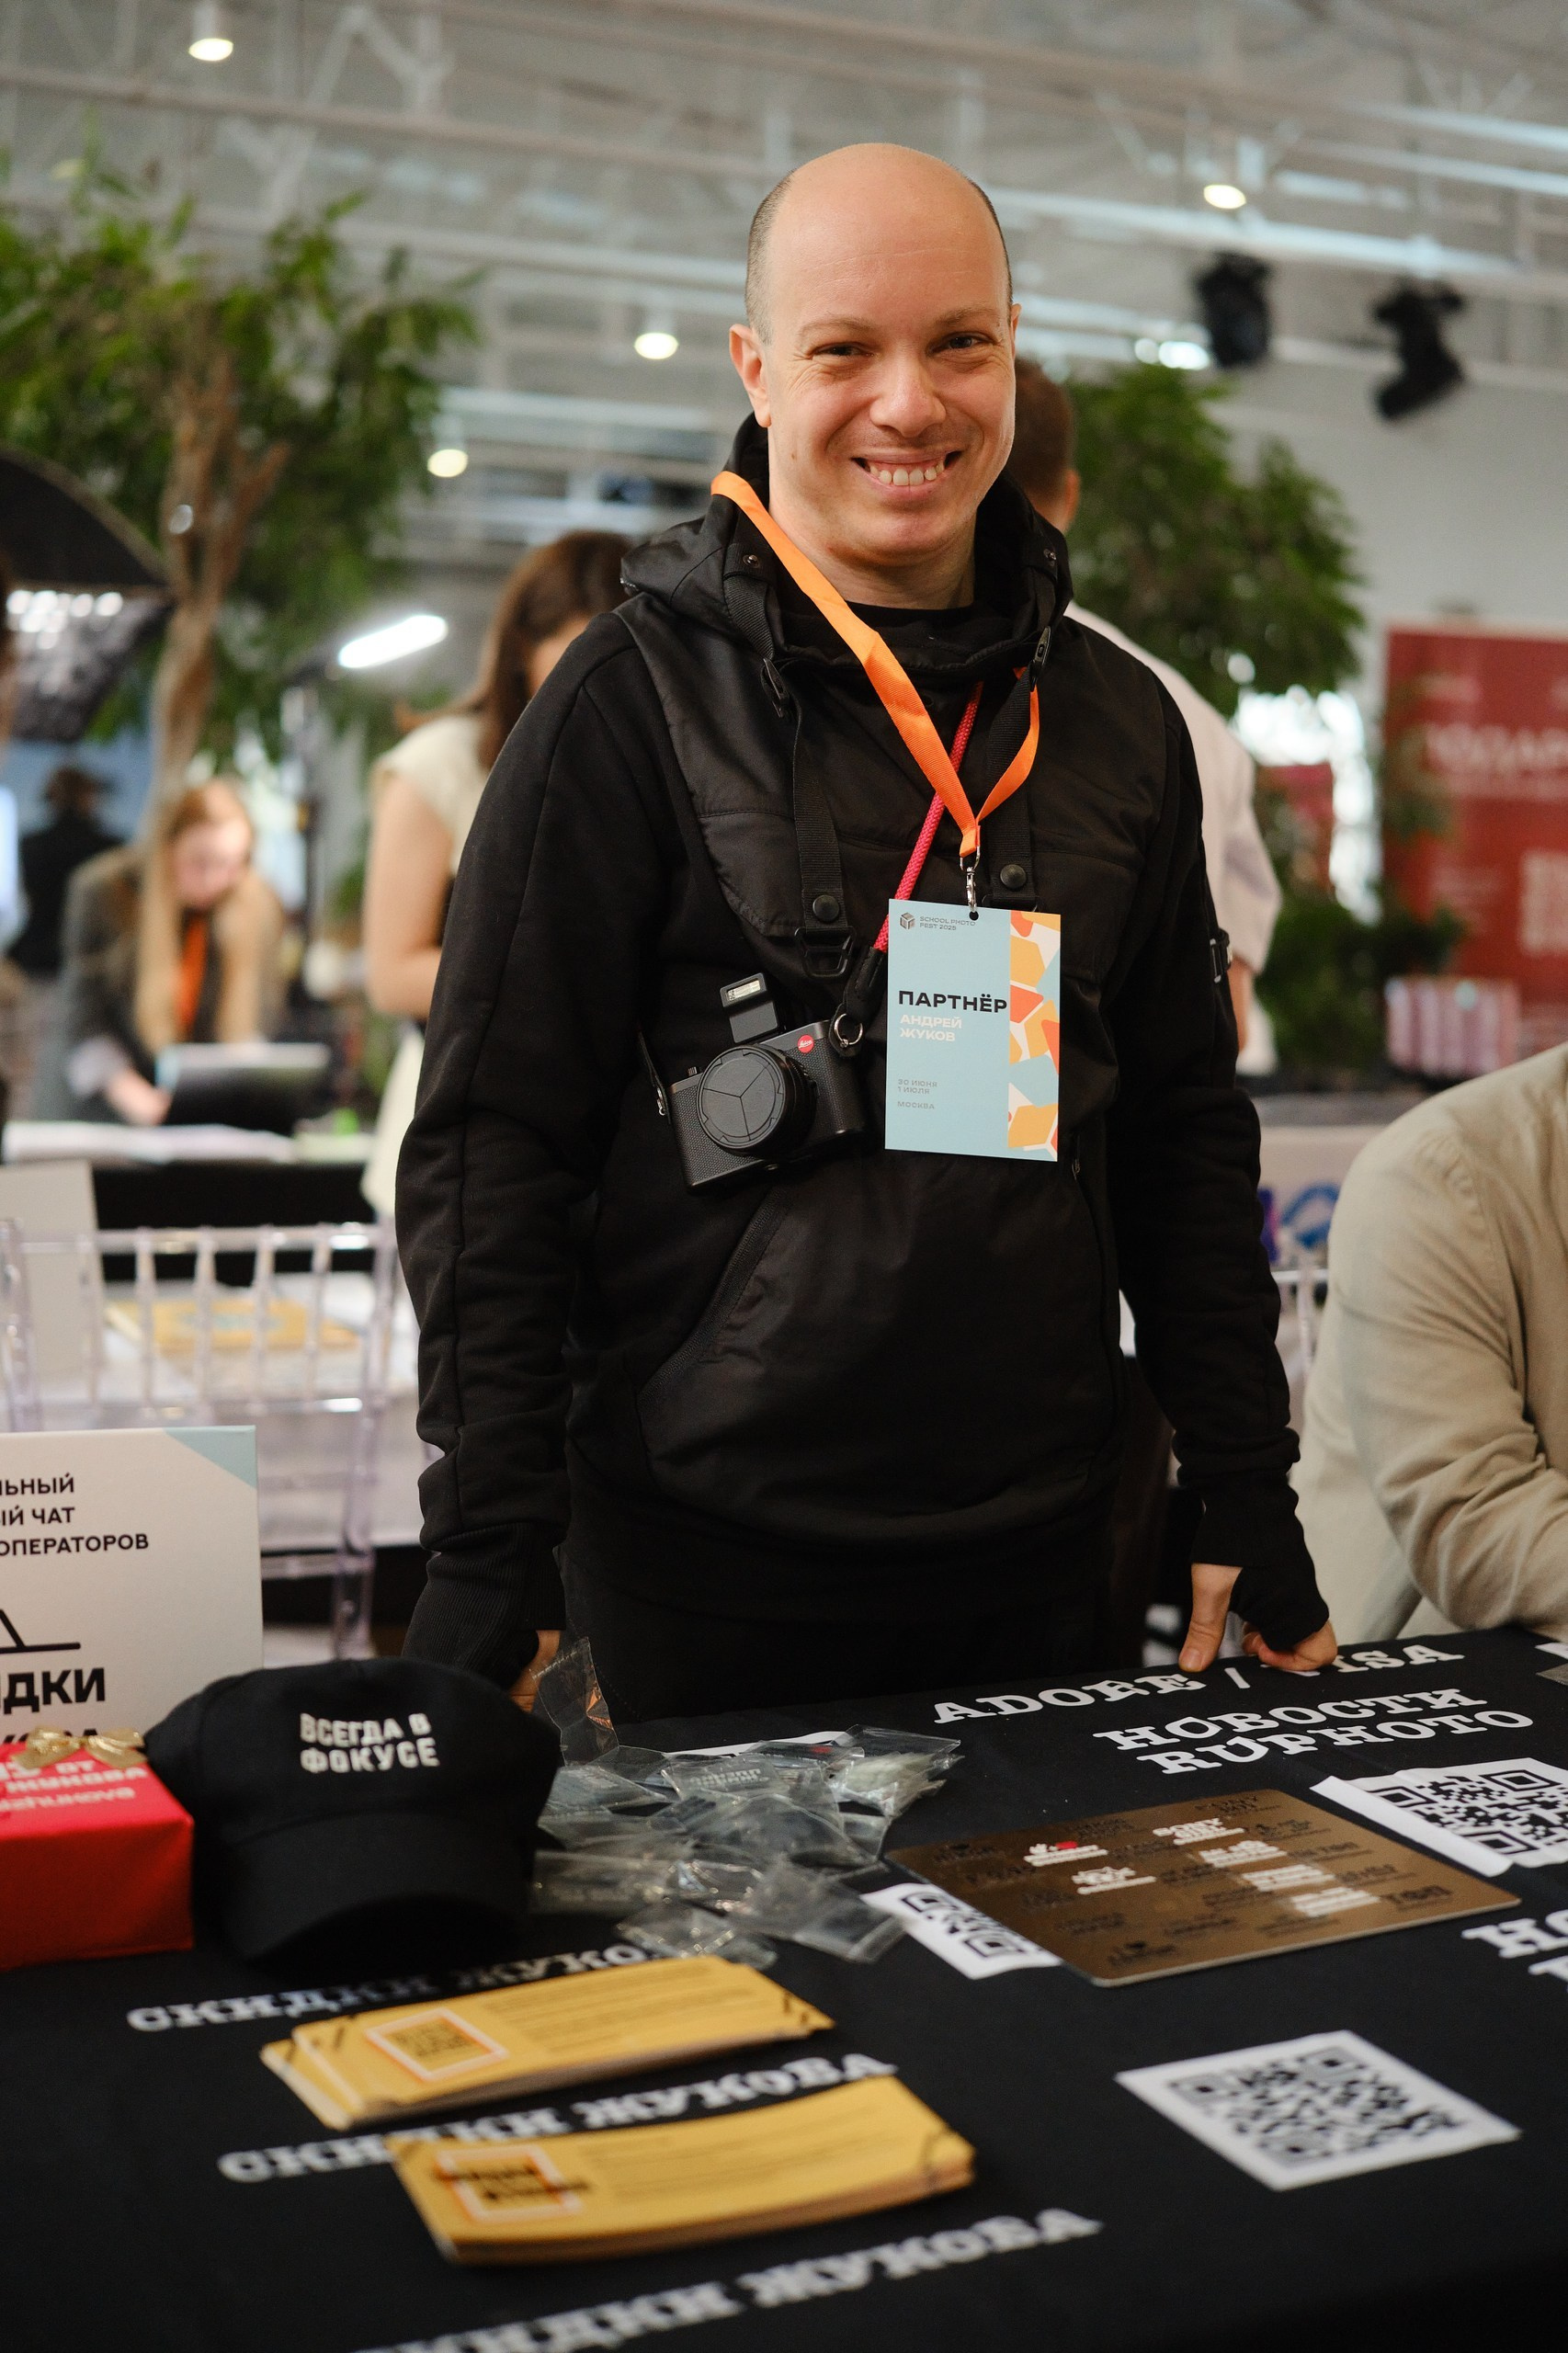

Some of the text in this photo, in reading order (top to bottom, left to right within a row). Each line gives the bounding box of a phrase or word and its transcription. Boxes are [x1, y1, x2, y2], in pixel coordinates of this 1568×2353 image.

[920, 915, 949, 925] SCHOOL
[899, 990, 1007, 1013] ПАРТНЁР
[900, 1014, 962, 1029] АНДРЕЙ
[900, 1028, 956, 1041] ЖУКОВ
[903, 1086, 930, 1095] ИЮЛЯ
[911, 1079, 937, 1087] ИЮНЯ
[897, 1100, 935, 1109] МОСКВА
[0, 1472, 74, 1496] ЬНЫЙ
[32, 1506, 75, 1525] ЧАТ
[0, 1534, 149, 1556] ОПЕРАТОРОВ
[1261, 1644, 1465, 1677] ISA
[300, 1712, 432, 1747] ВСЕГДА В
[1093, 1688, 1488, 1750] НОВОСТИ
[1136, 1711, 1533, 1774] RUPHOTO
[300, 1737, 440, 1774] ФОКУСЕ
[127, 1972, 440, 2033] СКИДКИ
[458, 1943, 647, 1989] ЖУКО
[571, 2052, 899, 2131] ЖУКОВА
[737, 2207, 1103, 2309] ЖУКОВА
